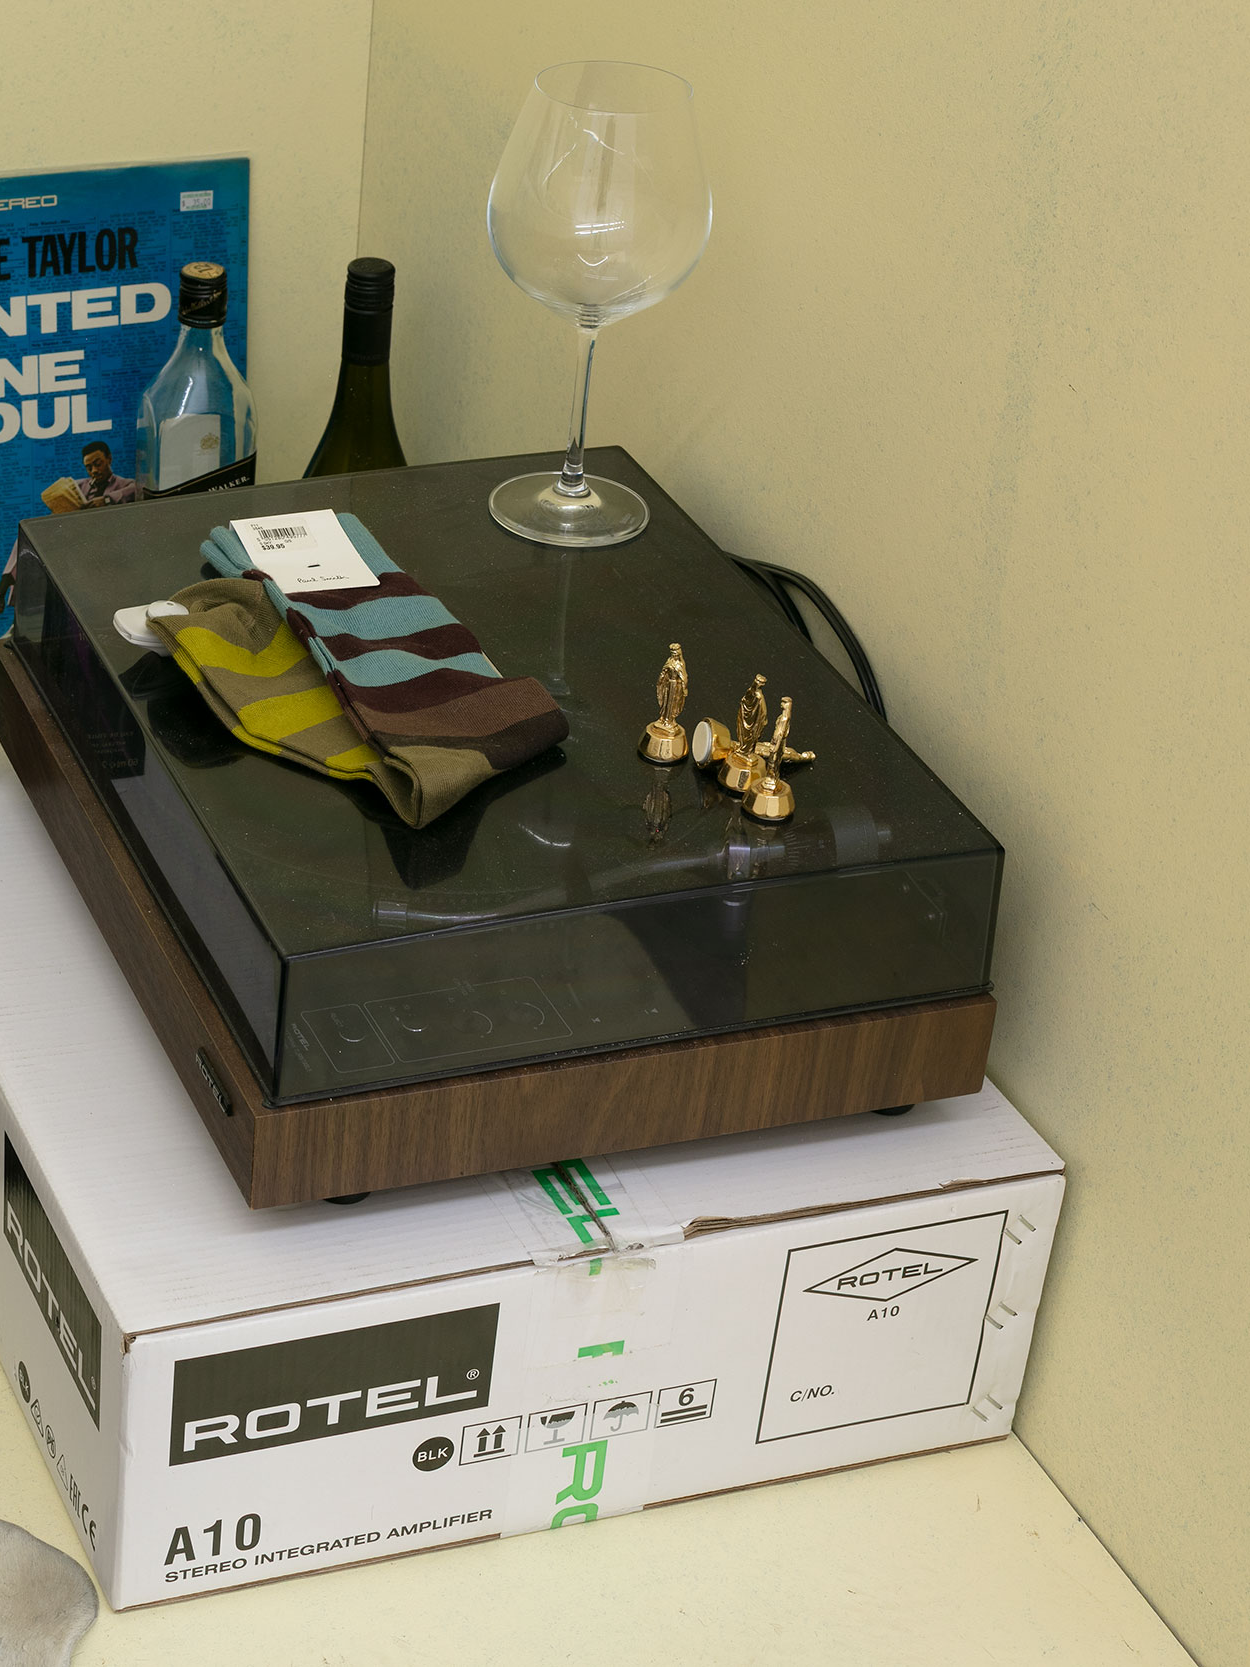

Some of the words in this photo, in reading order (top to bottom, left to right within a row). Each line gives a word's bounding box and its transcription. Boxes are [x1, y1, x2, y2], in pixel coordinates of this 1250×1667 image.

[22, 227, 139, 278] TAYLOR
[262, 543, 285, 551] $39.95
[195, 1052, 226, 1114] ROTEL
[837, 1262, 943, 1290] ROTEL
[6, 1201, 96, 1411] ROTEL
[866, 1305, 900, 1322] A10
[678, 1387, 695, 1407] 6
[790, 1384, 835, 1402] C/NO.
[182, 1376, 478, 1452] ROTEL
[417, 1446, 449, 1463] BLK
[164, 1512, 262, 1566] A10
[165, 1557, 248, 1583] STEREO
[253, 1531, 382, 1566] INTEGRATED
[386, 1509, 493, 1540] AMPLIFIER
